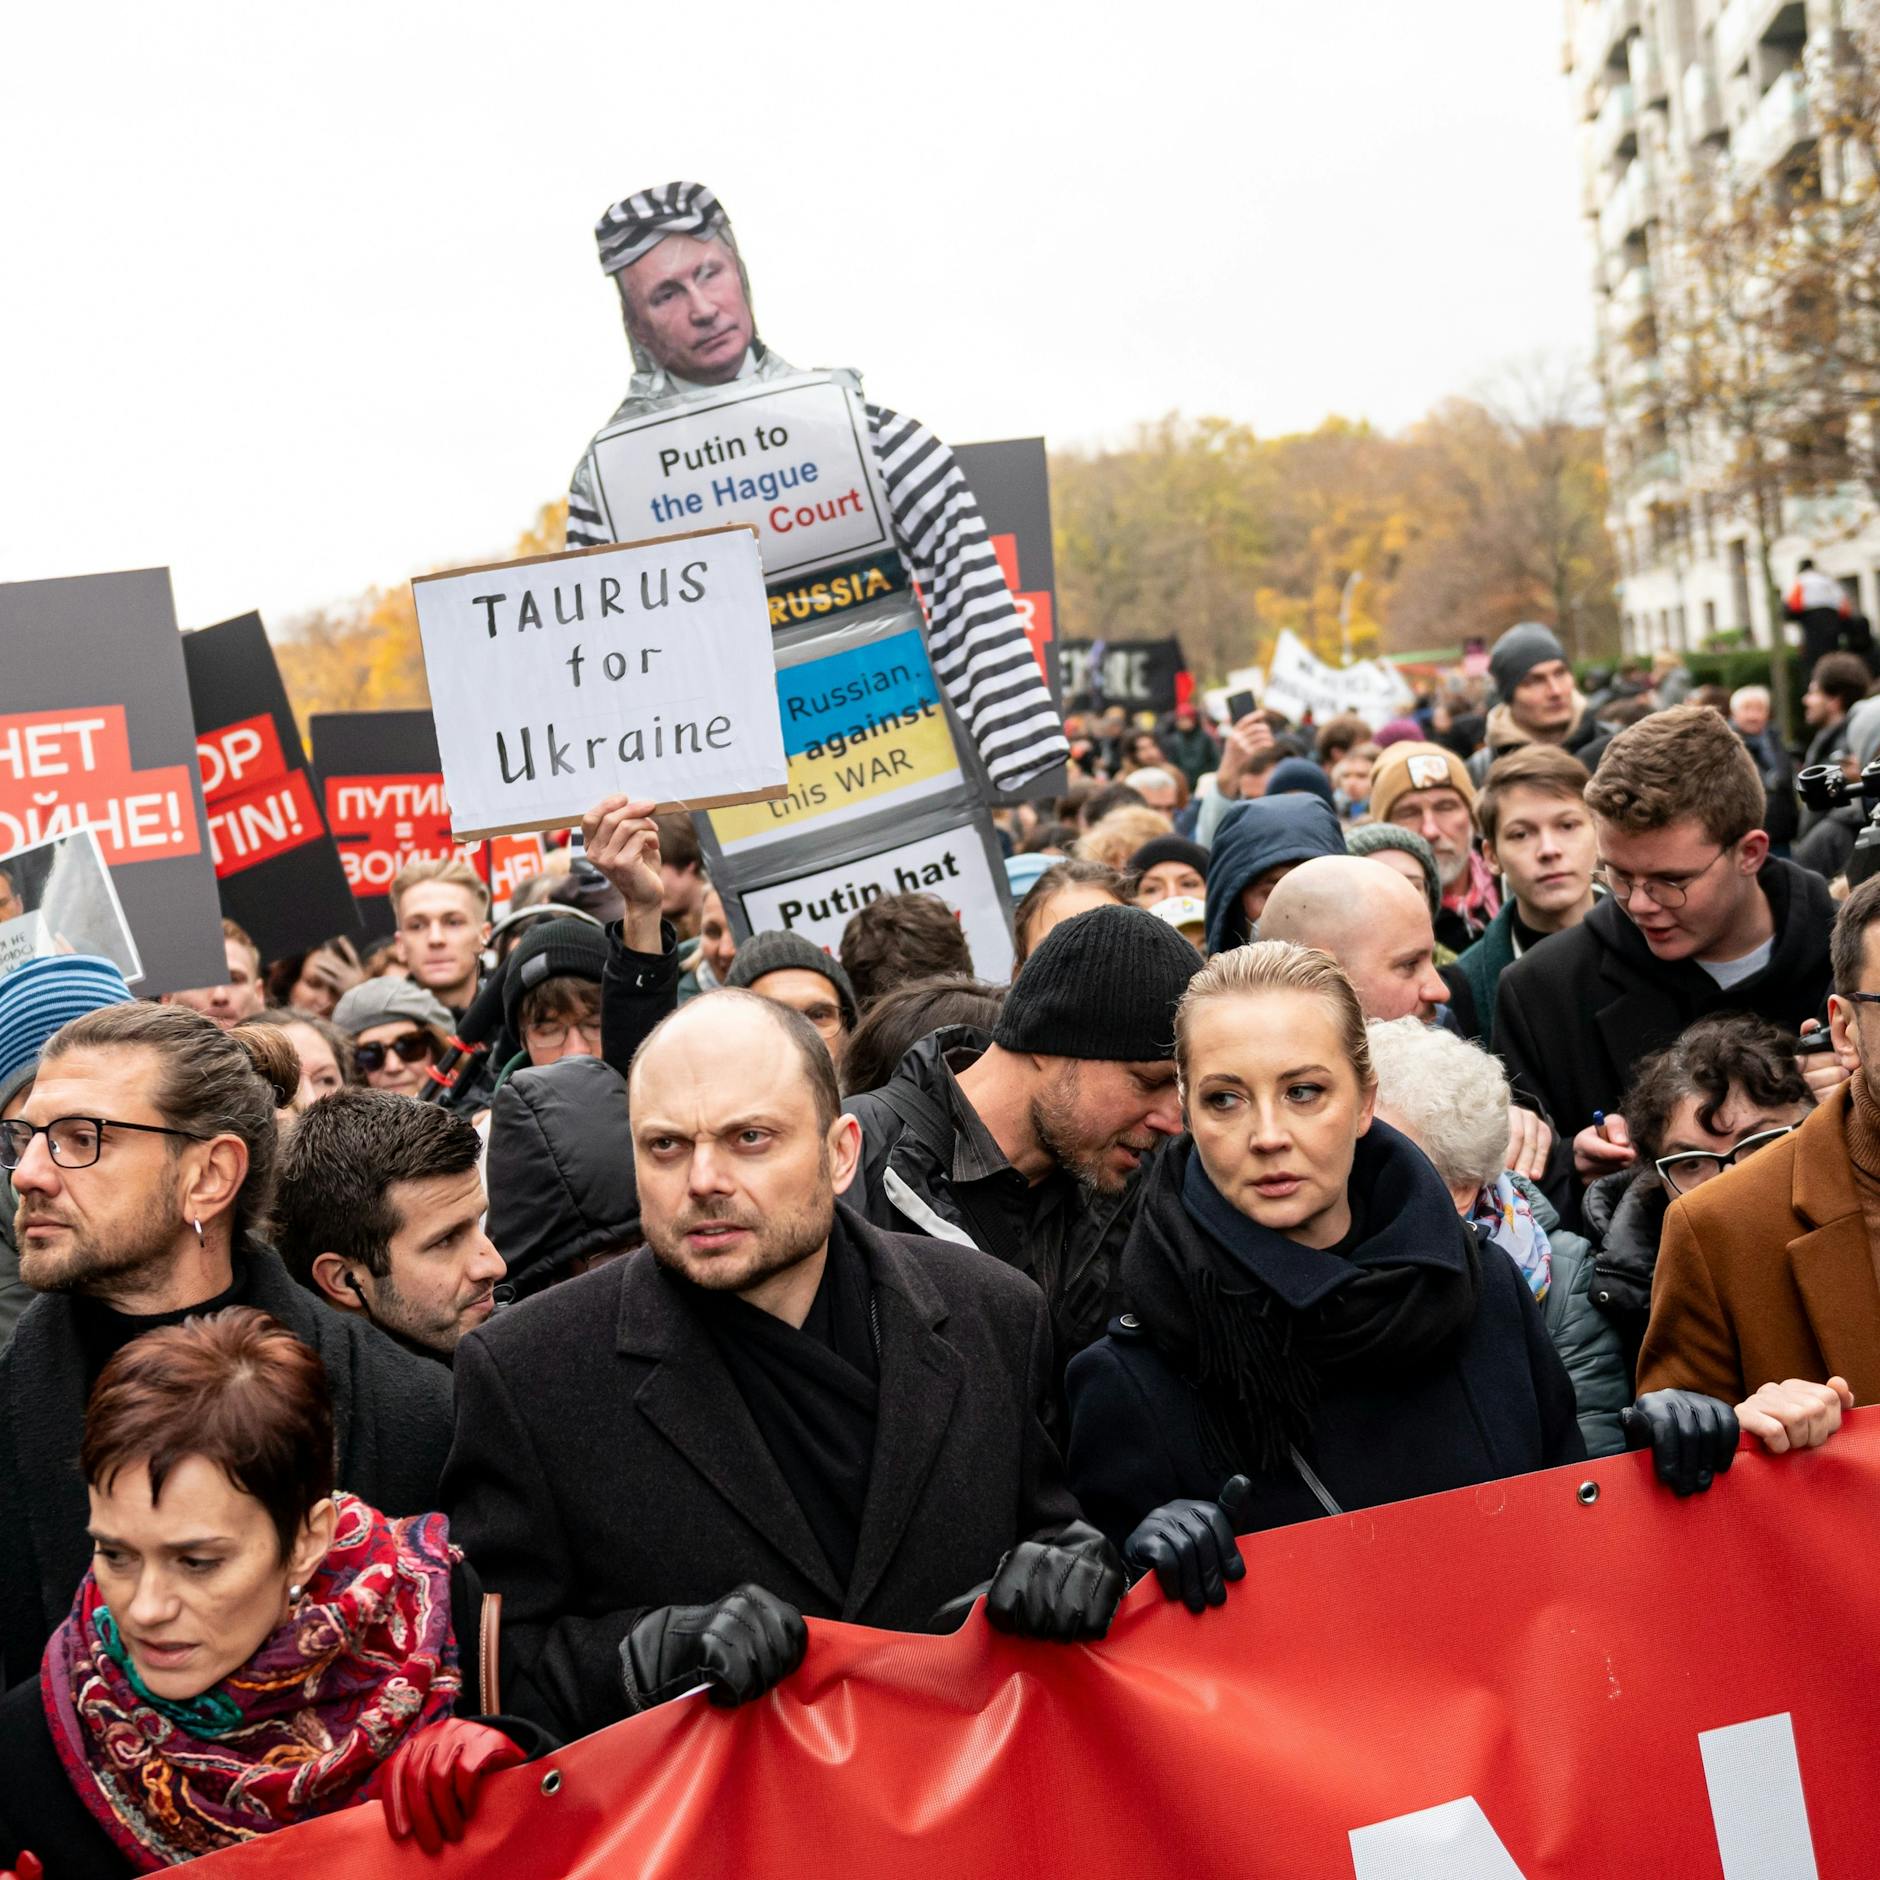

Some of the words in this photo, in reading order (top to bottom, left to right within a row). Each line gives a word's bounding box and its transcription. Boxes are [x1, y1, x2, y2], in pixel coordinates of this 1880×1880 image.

[659, 436, 746, 477] Putin
[755, 426, 788, 450] to
[650, 493, 703, 523] the
[712, 462, 819, 506] Hague
[769, 488, 864, 533] Court
[472, 562, 708, 638] TAURUS
[768, 568, 893, 625] RUSSIA
[566, 644, 662, 687] for
[786, 664, 921, 722] Russian.
[0, 719, 105, 779] НЕТ
[496, 715, 732, 784] Ukraine
[804, 697, 936, 760] against
[834, 749, 914, 793] WAR
[778, 882, 881, 928] Putin
[895, 851, 960, 894] hat
